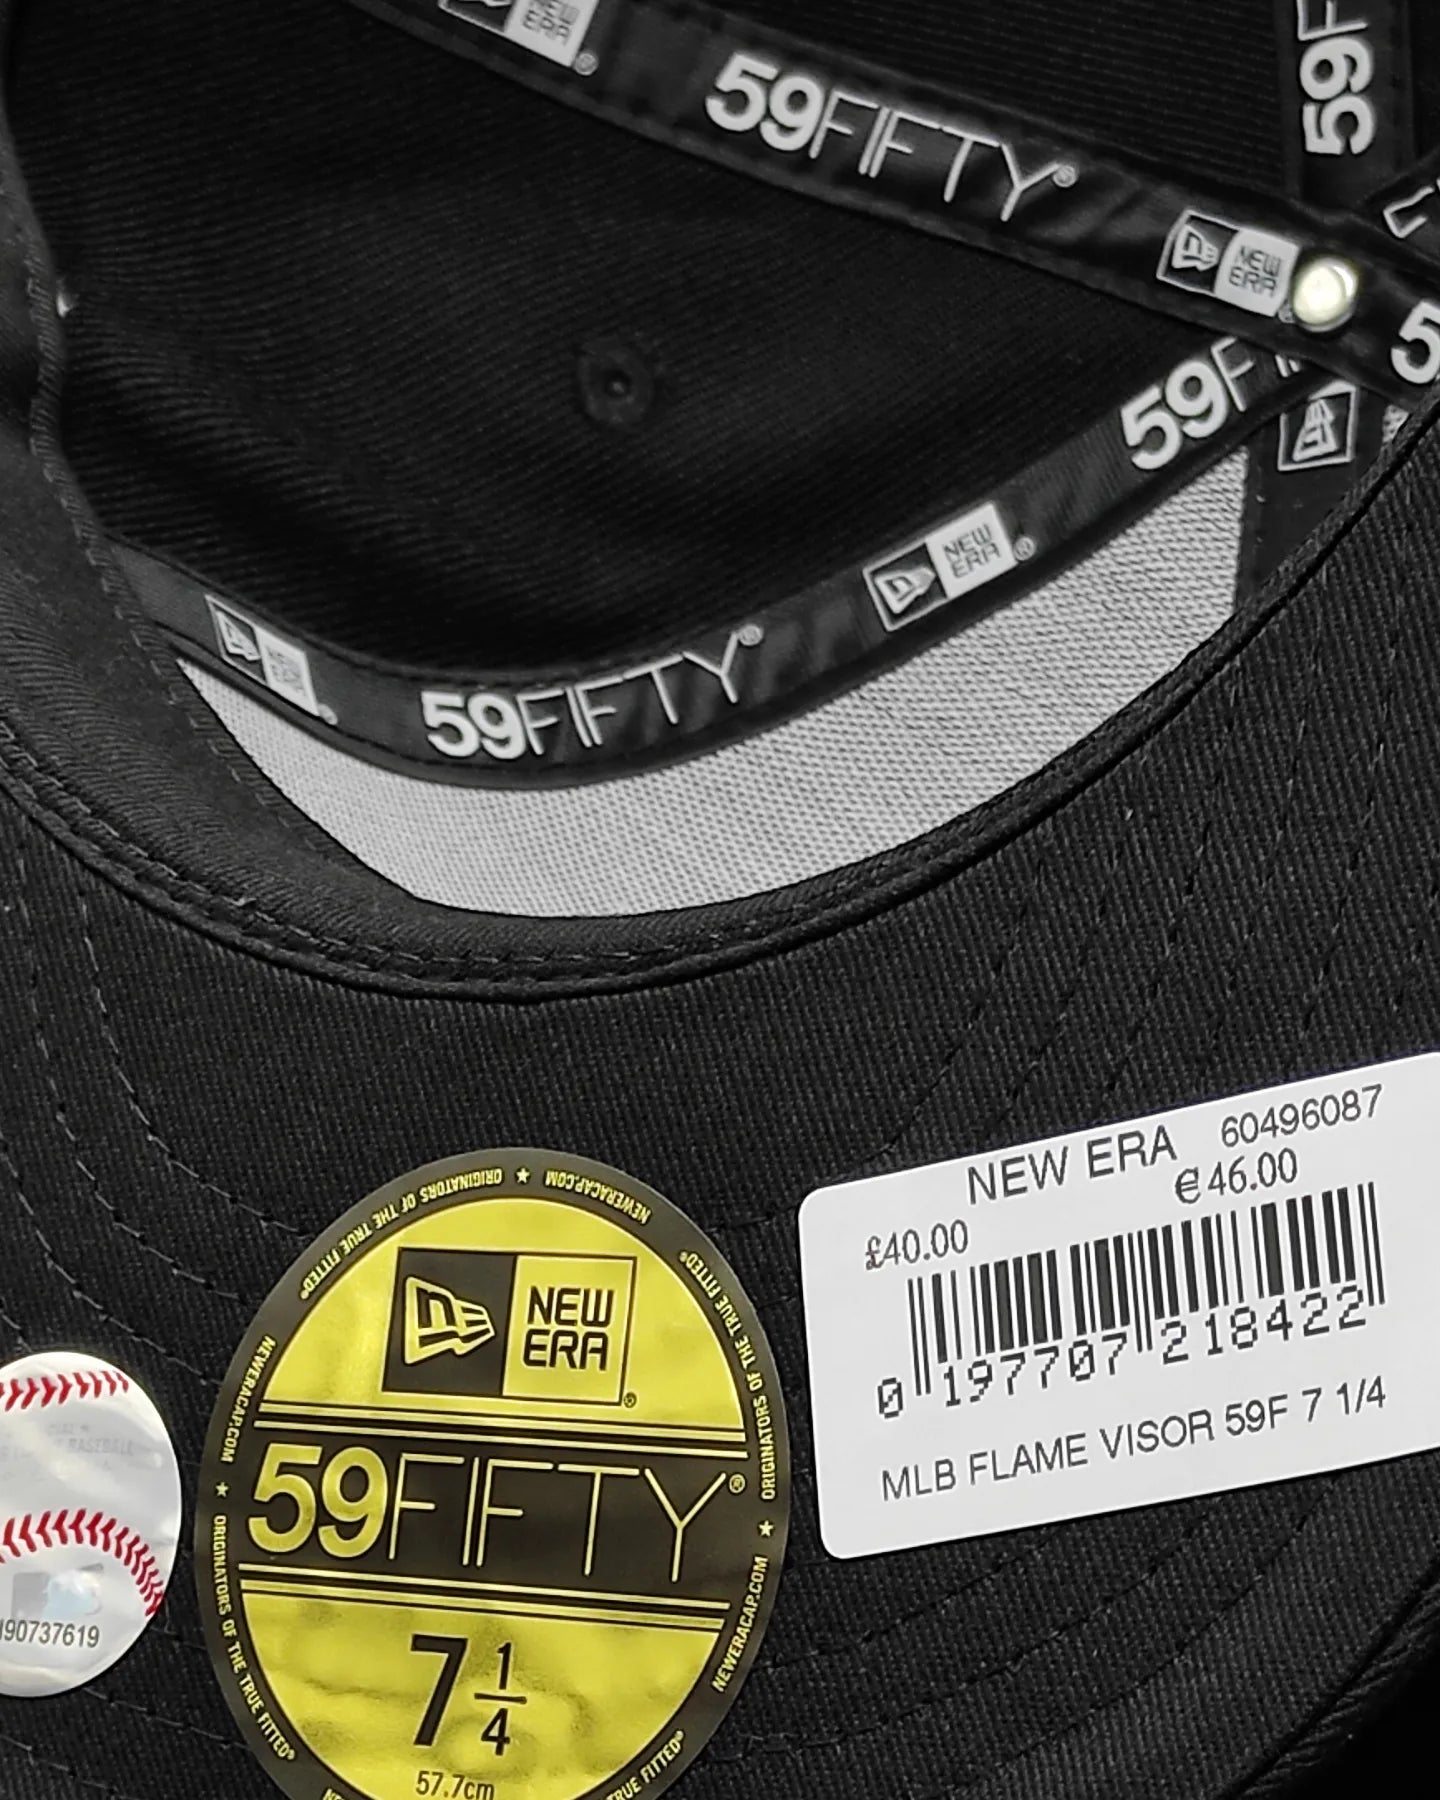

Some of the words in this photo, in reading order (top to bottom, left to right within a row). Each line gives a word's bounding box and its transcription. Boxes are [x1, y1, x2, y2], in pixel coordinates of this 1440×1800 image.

[1229, 266, 1277, 298] ERA
[1235, 246, 1281, 277] NEW
[942, 523, 993, 562] NEW
[951, 542, 1002, 579] ERA
[1221, 1084, 1384, 1148] 60496087
[419, 1168, 503, 1202] ORIGINATORS
[967, 1147, 1069, 1205] NEW
[1087, 1125, 1178, 1180] ERA
[371, 1204, 400, 1229] THE
[400, 1194, 417, 1213] OF
[545, 1170, 651, 1224] NEWERACAP.COM
[338, 1222, 374, 1256] TRUE
[865, 1220, 969, 1271] £40.00
[527, 1285, 615, 1328] NEW
[714, 1295, 742, 1337] TRUE
[523, 1328, 609, 1371] ERA
[734, 1335, 756, 1370] THE
[220, 1335, 277, 1463] NEWERACAP.COM
[747, 1372, 763, 1392] OF
[753, 1395, 776, 1500] ORIGINATORS
[881, 1459, 957, 1502] MLB
[969, 1433, 1088, 1485] FLAME
[1100, 1408, 1214, 1459] VISOR
[1225, 1394, 1290, 1438] 59F
[1302, 1387, 1323, 1422] 7
[1337, 1375, 1387, 1415] 1/4
[213, 1515, 232, 1615] ORIGINATORS
[222, 1619, 238, 1637] OF
[711, 1556, 769, 1692] NEWERACAP.COM
[227, 1641, 247, 1674] THE
[239, 1673, 265, 1714] TRUE
[410, 1633, 469, 1746] 7
[415, 1770, 495, 1800] 57.7cm
